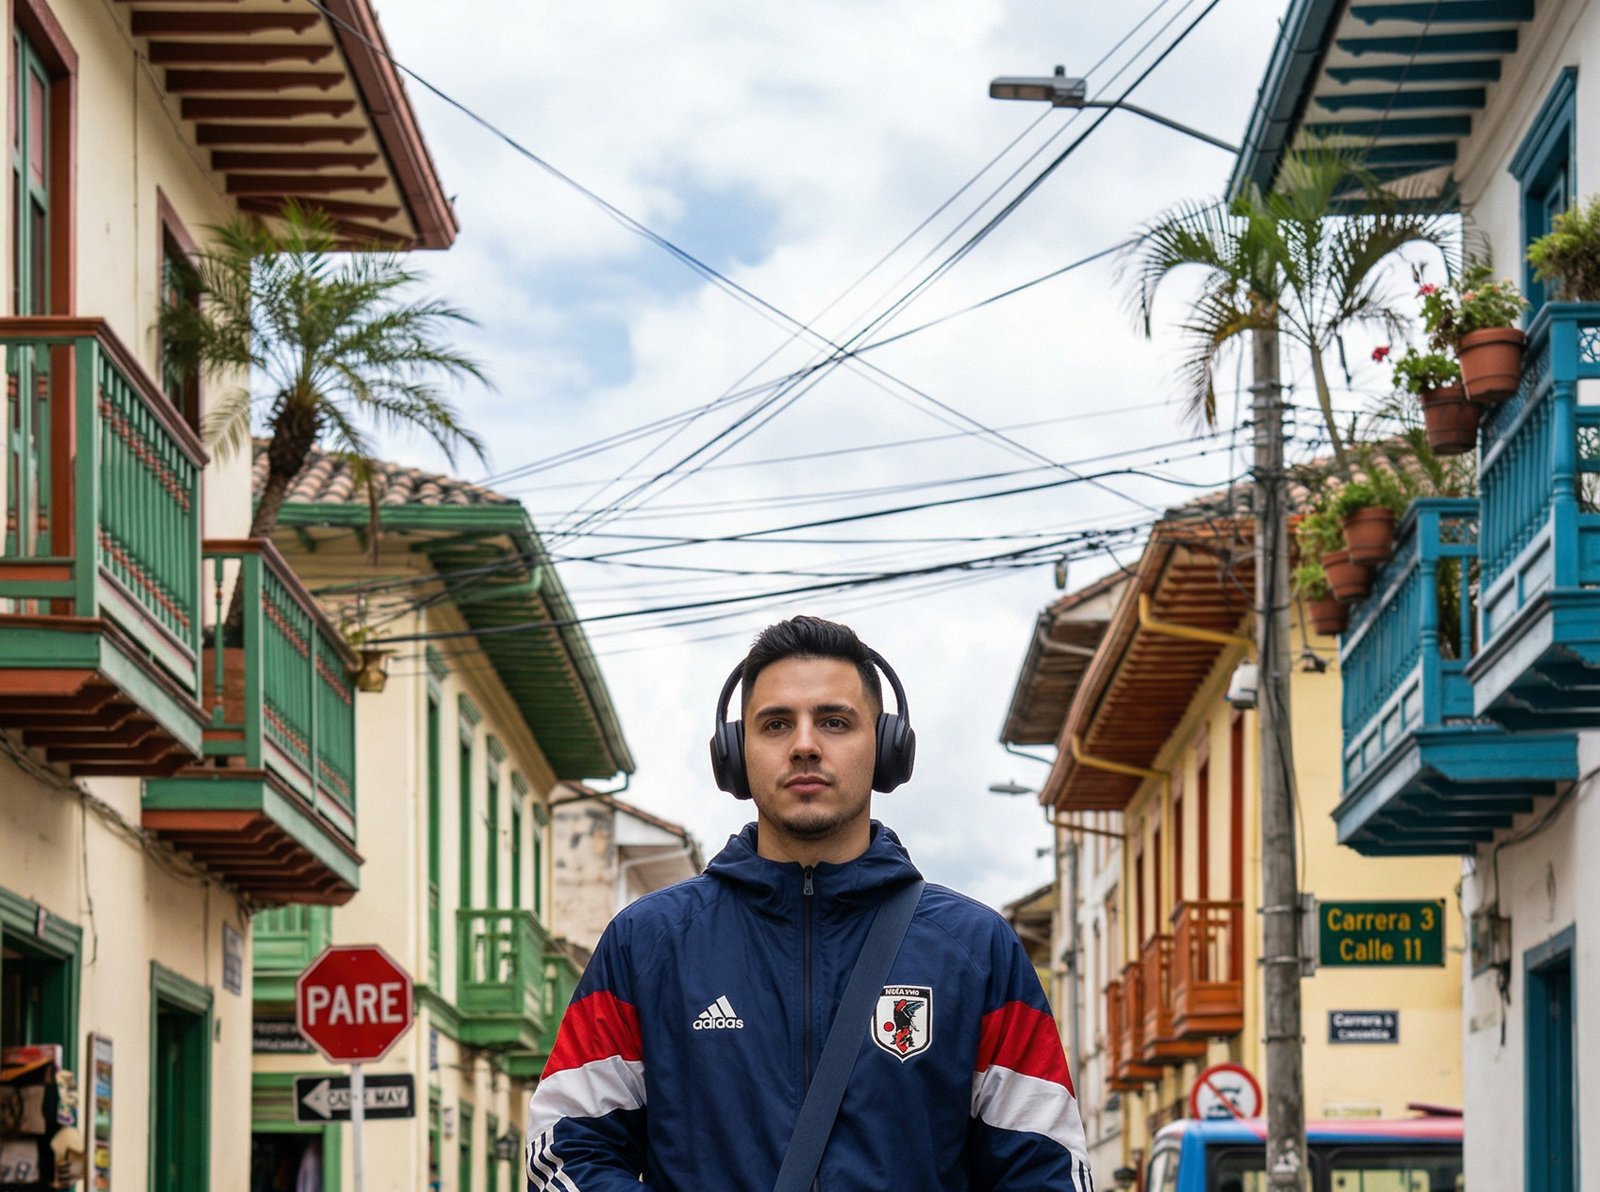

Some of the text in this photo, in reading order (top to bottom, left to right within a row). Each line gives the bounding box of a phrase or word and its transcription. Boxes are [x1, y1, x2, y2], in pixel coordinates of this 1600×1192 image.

[1327, 907, 1435, 931] Carrera 3
[1339, 938, 1422, 961] Calle 11
[306, 982, 403, 1026] PARE
[692, 1016, 744, 1030] adidas
